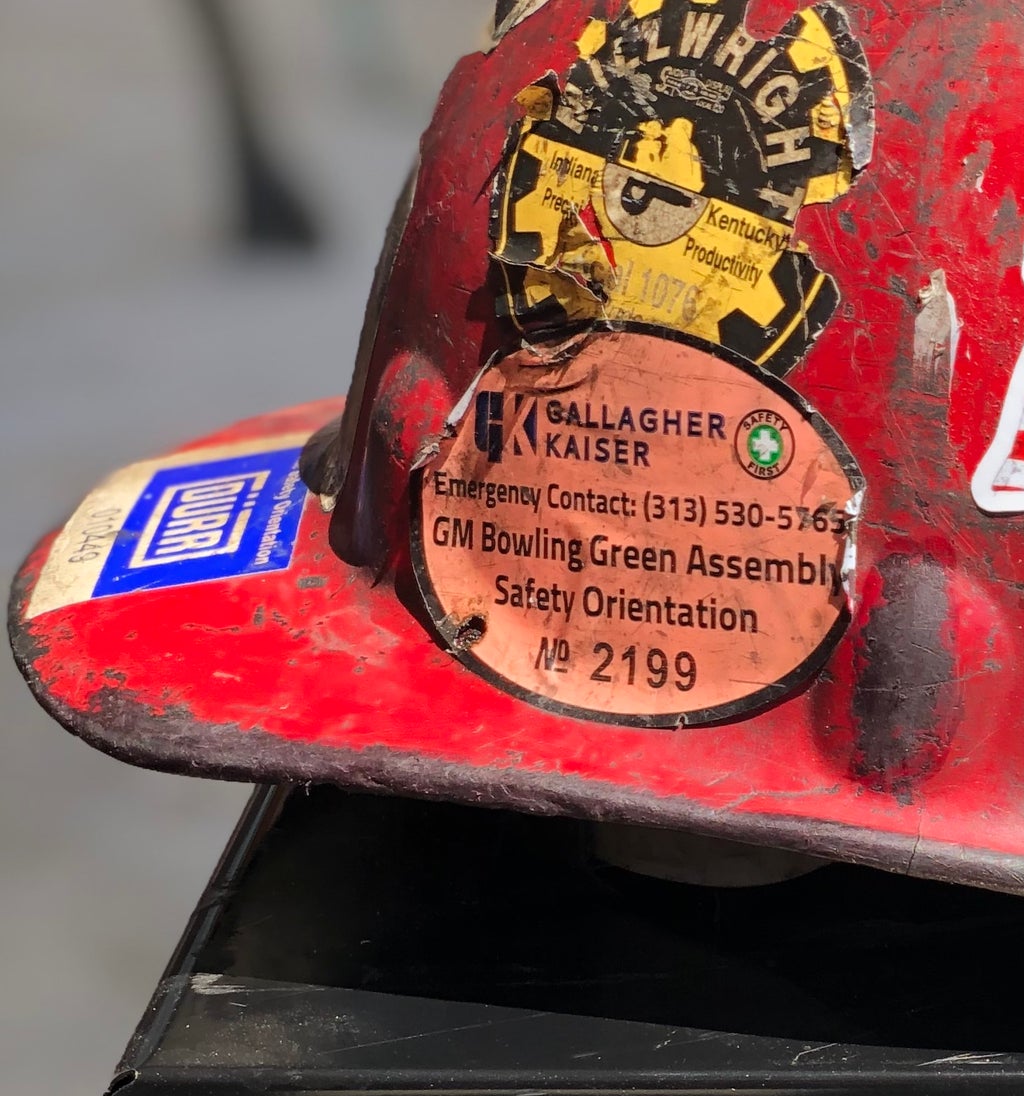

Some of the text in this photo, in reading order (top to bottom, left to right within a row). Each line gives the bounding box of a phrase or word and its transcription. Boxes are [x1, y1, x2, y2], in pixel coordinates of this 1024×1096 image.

[549, 150, 601, 188] Indiana
[706, 203, 788, 254] Kentucky
[682, 236, 763, 289] Productivity
[546, 399, 727, 440] GALLAGHER
[743, 412, 789, 431] SAFETY
[545, 432, 650, 467] KAISER
[747, 462, 781, 477] FIRST
[434, 471, 541, 508] Emergency
[547, 483, 637, 518] Contact:
[643, 490, 707, 527] (313)
[254, 500, 292, 565] Orientation
[432, 516, 474, 550] GM
[481, 524, 584, 571] Bowling
[590, 535, 677, 574] Green
[495, 575, 758, 633] Safety Orientation
[590, 642, 698, 692] 2199
